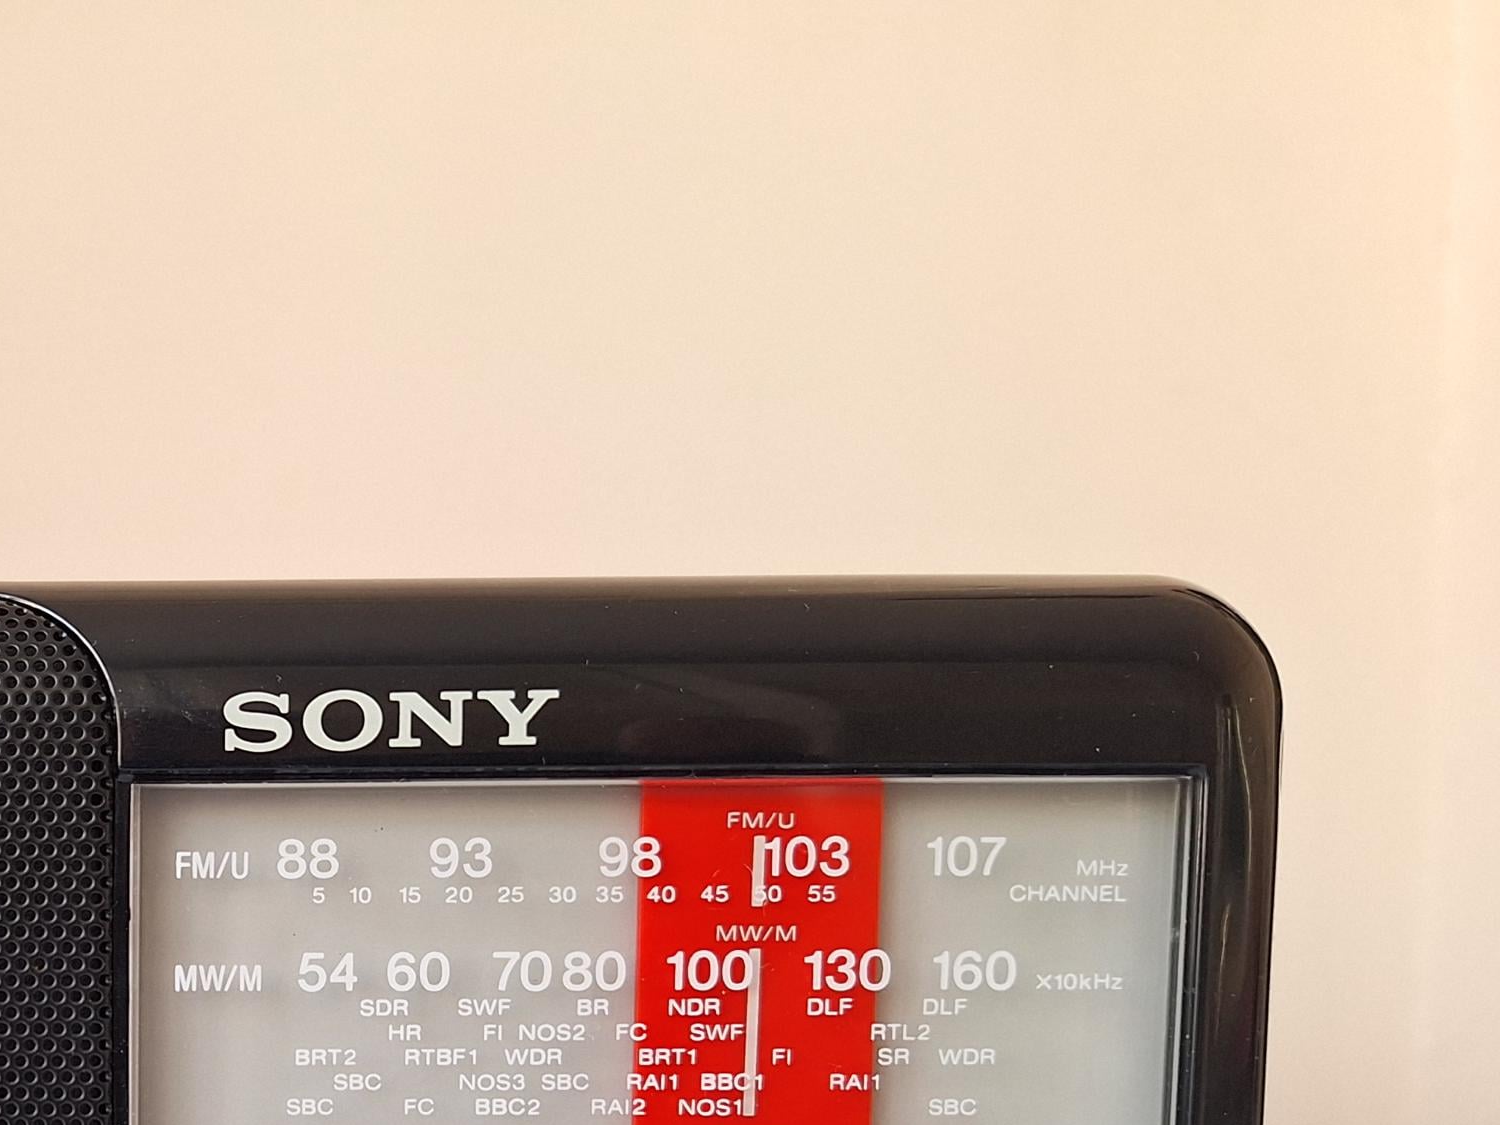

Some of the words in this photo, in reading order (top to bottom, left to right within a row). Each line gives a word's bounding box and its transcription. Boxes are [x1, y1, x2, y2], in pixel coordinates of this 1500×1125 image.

[224, 689, 559, 752] SONY
[728, 812, 794, 829] FM/U
[176, 852, 248, 879] FM/U
[277, 838, 339, 879] 88
[430, 837, 492, 878] 93
[598, 837, 662, 877] 98
[765, 836, 850, 877] 103
[927, 836, 1007, 876] 107
[1077, 860, 1128, 876] MHz
[313, 888, 325, 903] 5
[350, 887, 371, 903] 10
[400, 887, 421, 903] 15
[446, 887, 472, 903] 20
[498, 887, 524, 902] 25
[549, 886, 576, 903] 30
[596, 886, 623, 902] 35
[647, 886, 676, 903] 40
[701, 885, 729, 902] 45
[808, 885, 835, 902] 55
[1010, 885, 1126, 902] CHANNEL
[716, 925, 796, 941] MW/M
[175, 965, 261, 992] MW/M
[298, 953, 357, 992] 54
[388, 952, 450, 991] 60
[493, 951, 552, 991] 70
[563, 951, 626, 991] 80
[666, 950, 753, 991] 100
[804, 949, 890, 991] 130
[933, 950, 1016, 991] 160
[360, 999, 408, 1016] SDR
[458, 999, 511, 1016] SWF
[578, 999, 608, 1015] BR
[669, 998, 720, 1016] NDR
[807, 998, 852, 1015] DLF
[923, 999, 967, 1015] DLF
[389, 1025, 421, 1040] HR
[484, 1025, 502, 1040] FI
[519, 1024, 585, 1041] NOS2
[617, 1023, 647, 1041] FC
[689, 1024, 745, 1041] SWF
[871, 1024, 929, 1041] RTL2
[296, 1049, 356, 1065] BRT2
[405, 1048, 476, 1065] RTBF1
[505, 1048, 562, 1065] WDR
[639, 1048, 695, 1065] BRT1
[773, 1048, 791, 1065] FI
[878, 1048, 909, 1065] SR
[939, 1048, 995, 1065] WDR
[334, 1074, 381, 1090] SBC
[460, 1074, 525, 1091] NOS3
[542, 1074, 588, 1090] SBC
[627, 1074, 678, 1091] RAI1
[700, 1074, 764, 1091] BBC1
[830, 1074, 879, 1090] RAI1
[287, 1099, 333, 1115] SBC
[405, 1098, 434, 1115] FC
[476, 1098, 540, 1115] BBC2
[592, 1099, 646, 1116] RAI2
[678, 1099, 742, 1116] NOS1
[929, 1099, 976, 1115] SBC
